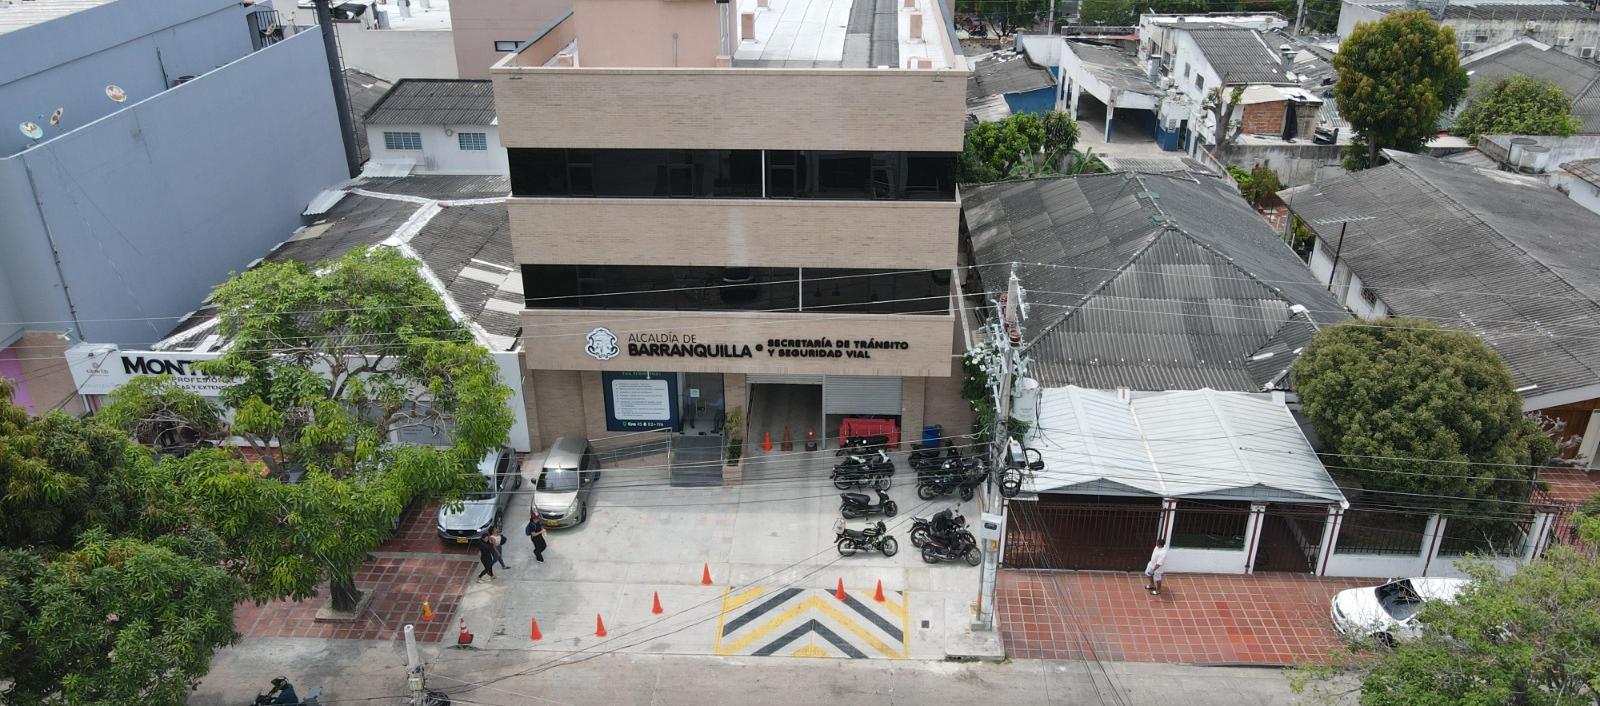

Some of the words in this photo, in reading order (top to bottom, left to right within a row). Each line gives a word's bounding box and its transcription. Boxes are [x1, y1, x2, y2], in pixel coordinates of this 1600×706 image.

[628, 332, 679, 343] ALCALDÍA
[683, 334, 697, 344] DE
[767, 337, 832, 348] SECRETARÍA
[836, 339, 850, 348] DE
[854, 337, 909, 350] TRÁNSITO
[628, 343, 753, 358] BARRANQUILLA
[768, 348, 775, 357] Y
[778, 349, 843, 357] SEGURIDAD
[846, 350, 870, 359] VIAL
